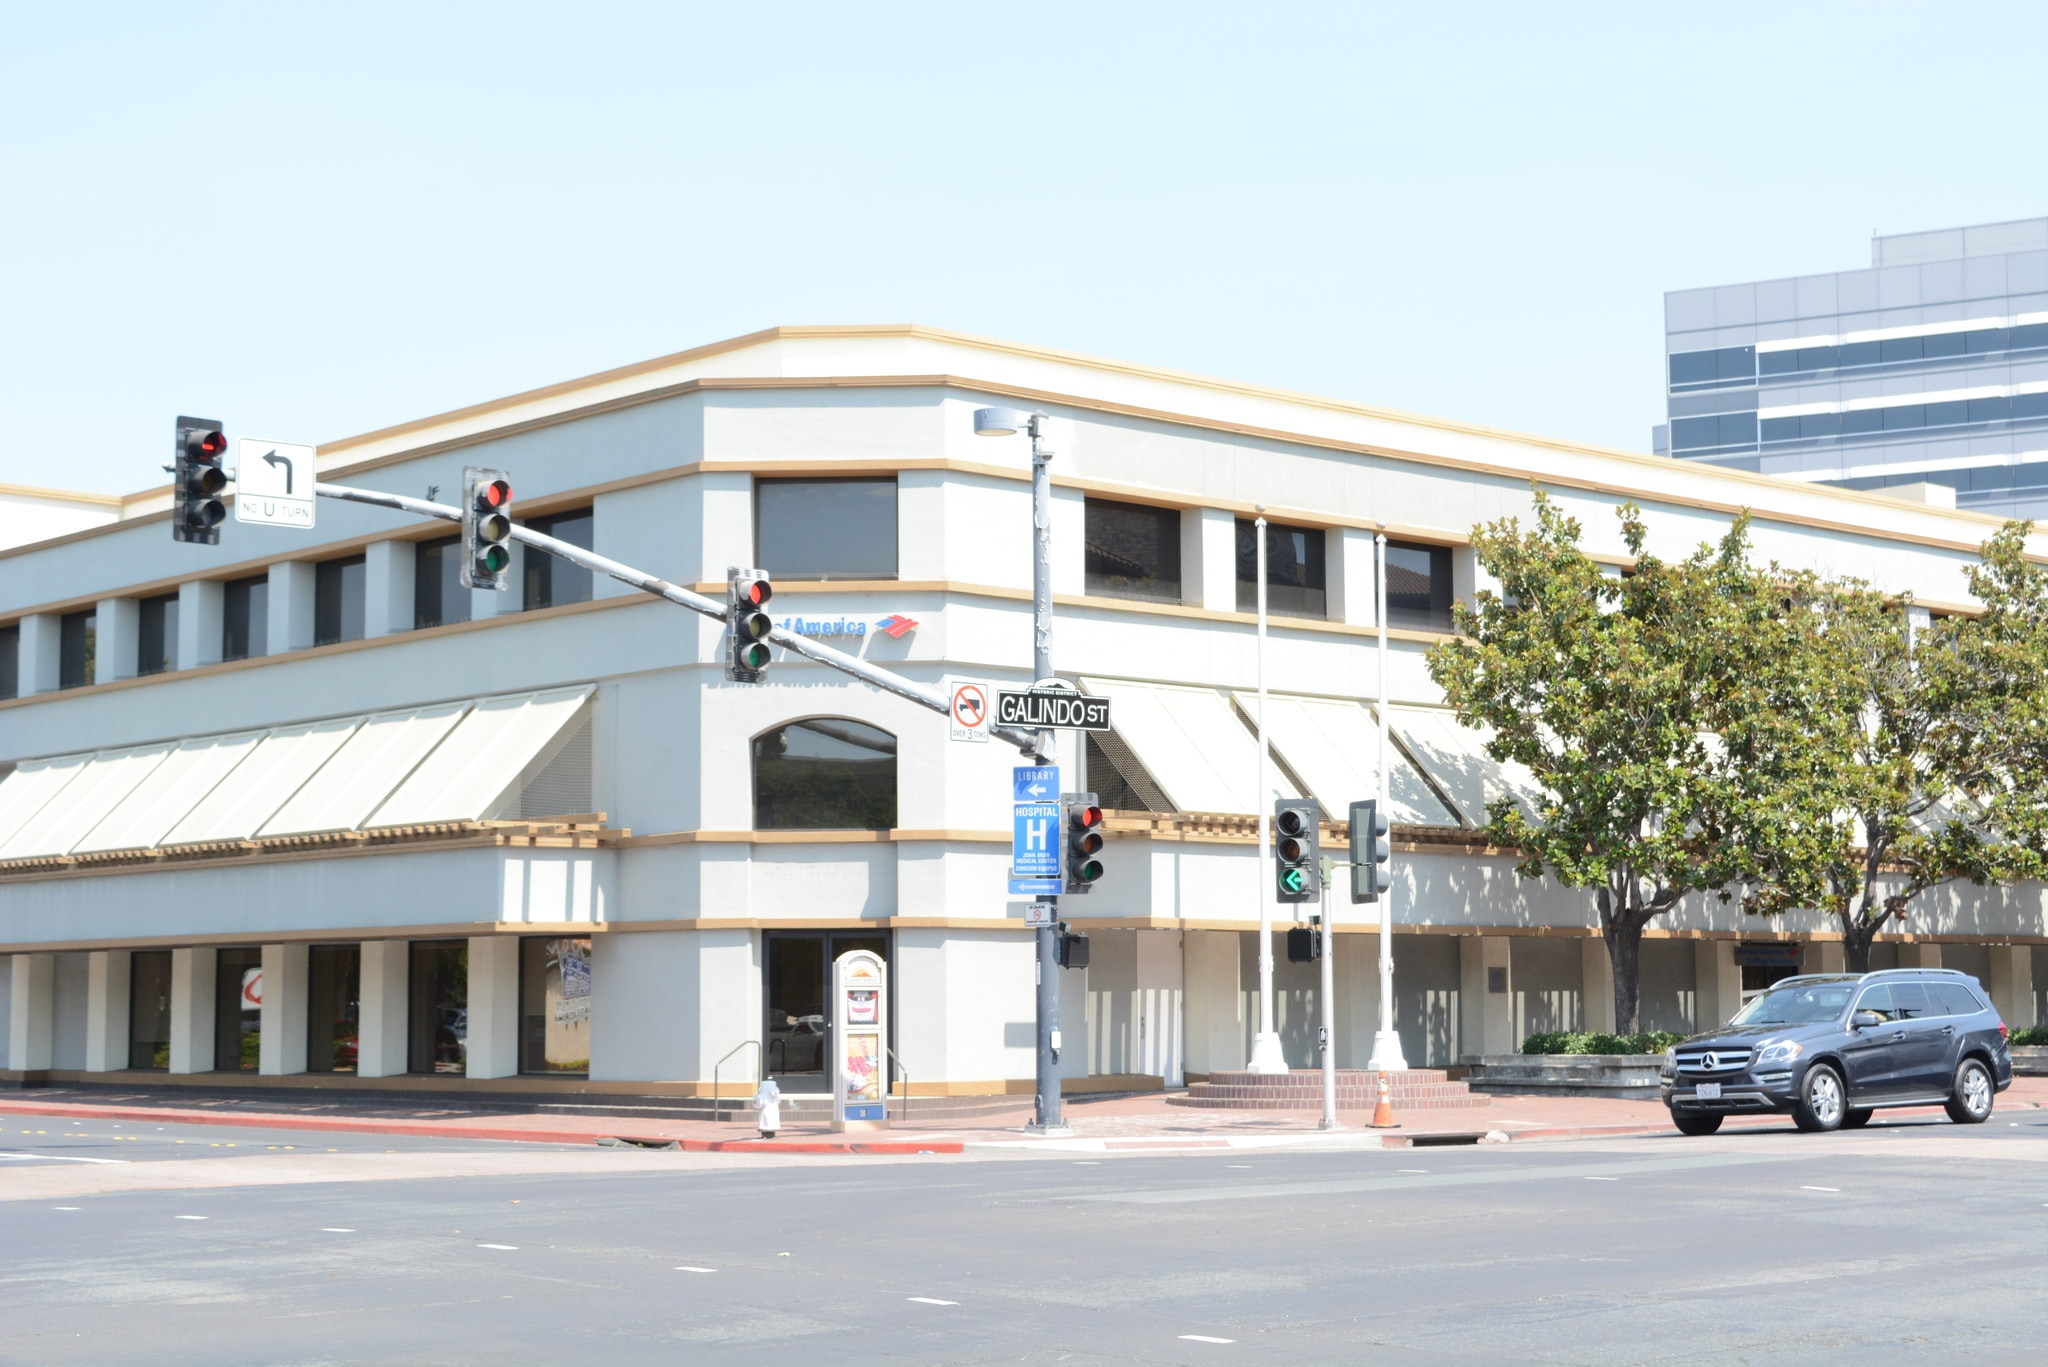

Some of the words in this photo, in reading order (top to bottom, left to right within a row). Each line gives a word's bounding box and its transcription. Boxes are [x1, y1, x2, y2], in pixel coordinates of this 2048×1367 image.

[243, 503, 257, 513] NO
[264, 502, 275, 516] U
[282, 506, 309, 517] TURN
[793, 617, 866, 634] America
[1001, 696, 1085, 725] GALINDO
[1087, 705, 1107, 723] ST
[953, 729, 966, 737] OVER
[967, 728, 973, 740] 3
[973, 730, 987, 739] TONS
[1018, 770, 1054, 781] LIBRARY
[1015, 807, 1058, 817] HOSPITAL
[1026, 818, 1047, 850] H
